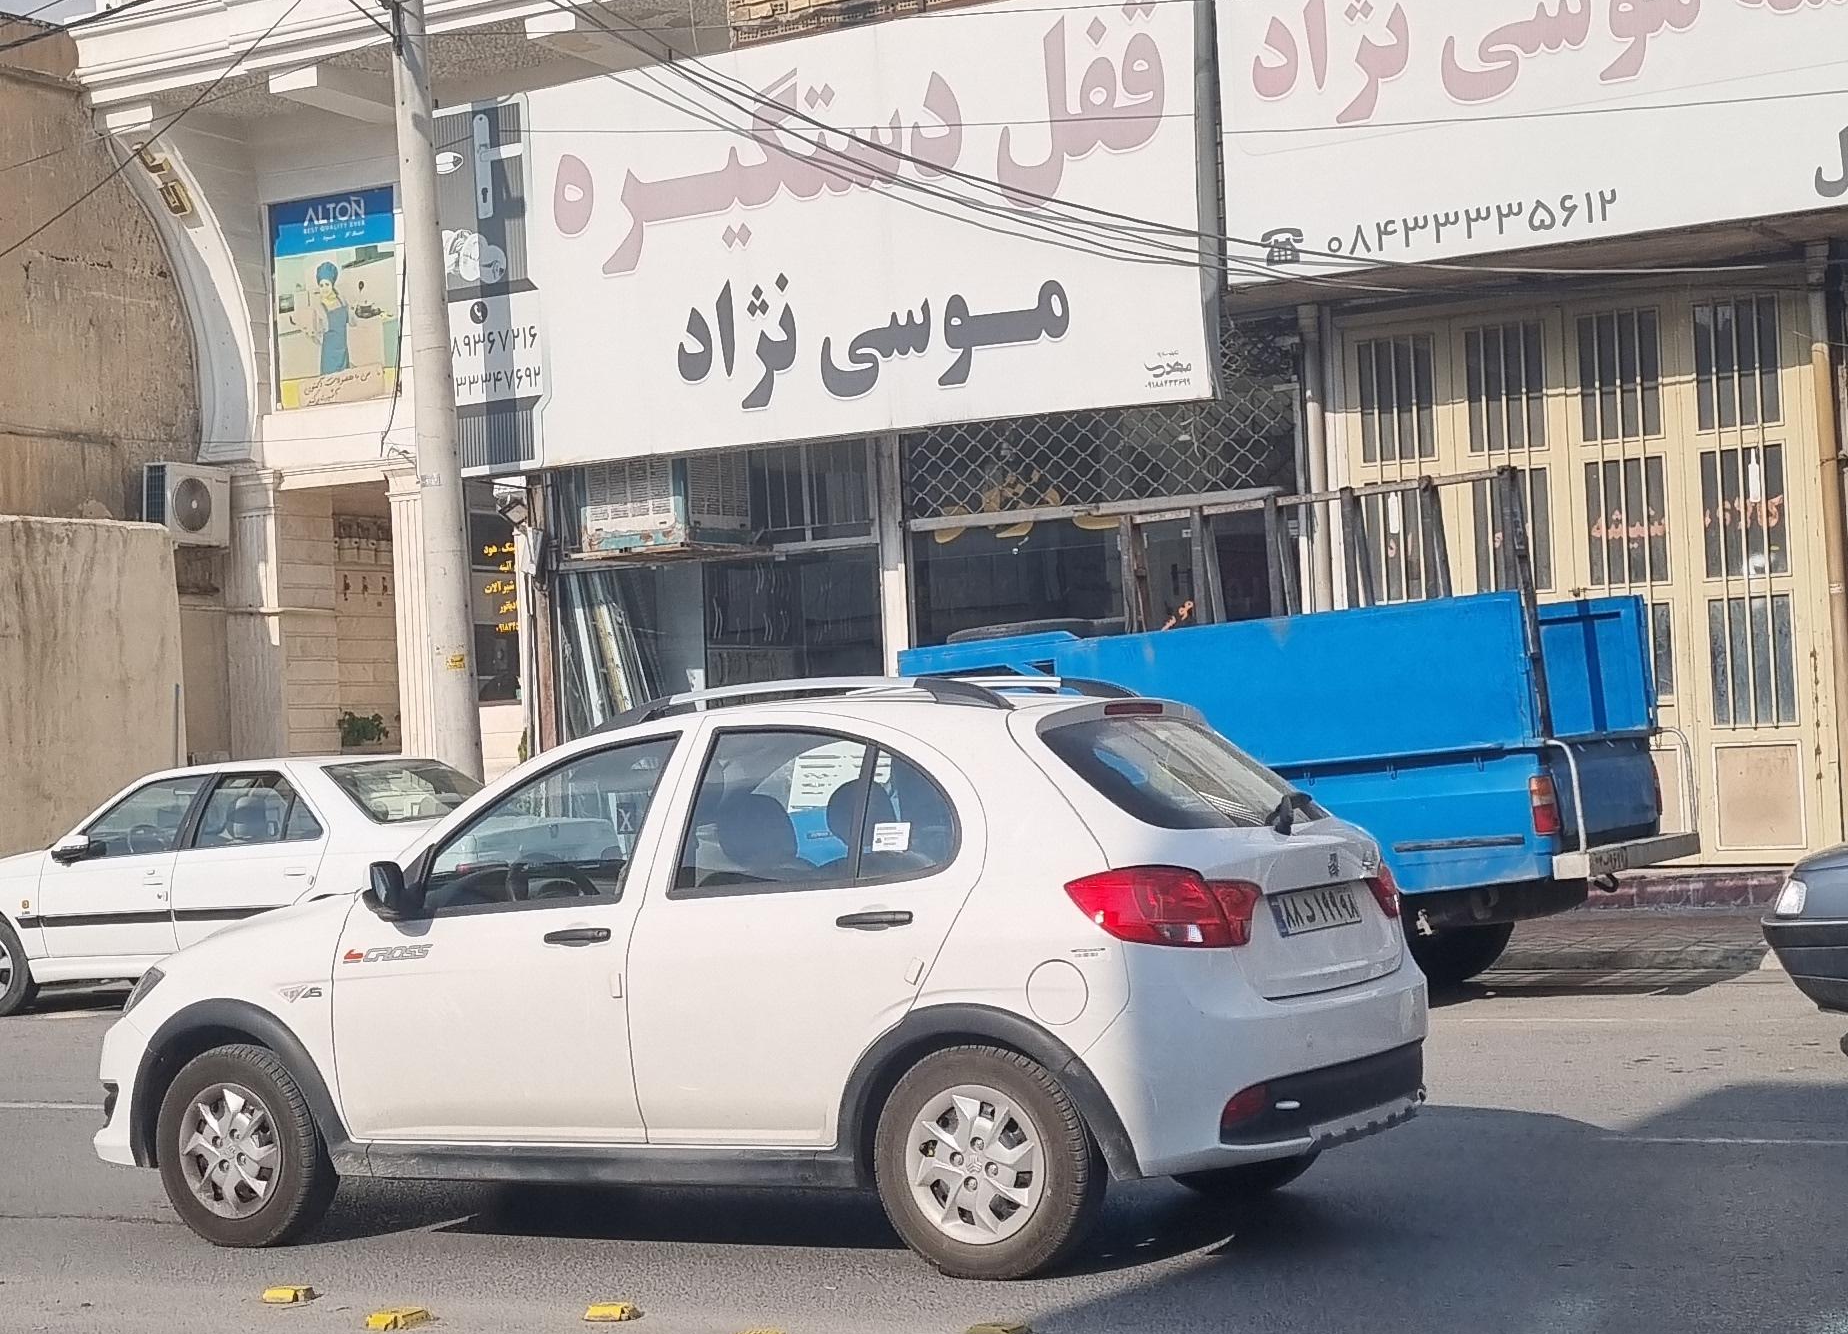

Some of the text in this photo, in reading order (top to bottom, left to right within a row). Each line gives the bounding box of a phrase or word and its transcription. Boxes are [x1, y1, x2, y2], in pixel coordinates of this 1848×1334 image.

[553, 67, 963, 275] دستگیره
[303, 195, 365, 227] ALTON
[1326, 187, 1617, 256] ۰۸۴۳۳۳۳۵۶۱۲
[451, 325, 537, 357] ۸۹۳۶۷۲۱۶
[678, 272, 1070, 410] موسی نژاد
[455, 365, 541, 397] ۳۳۳۴۷۶۹۲
[363, 943, 434, 963] CROSS
